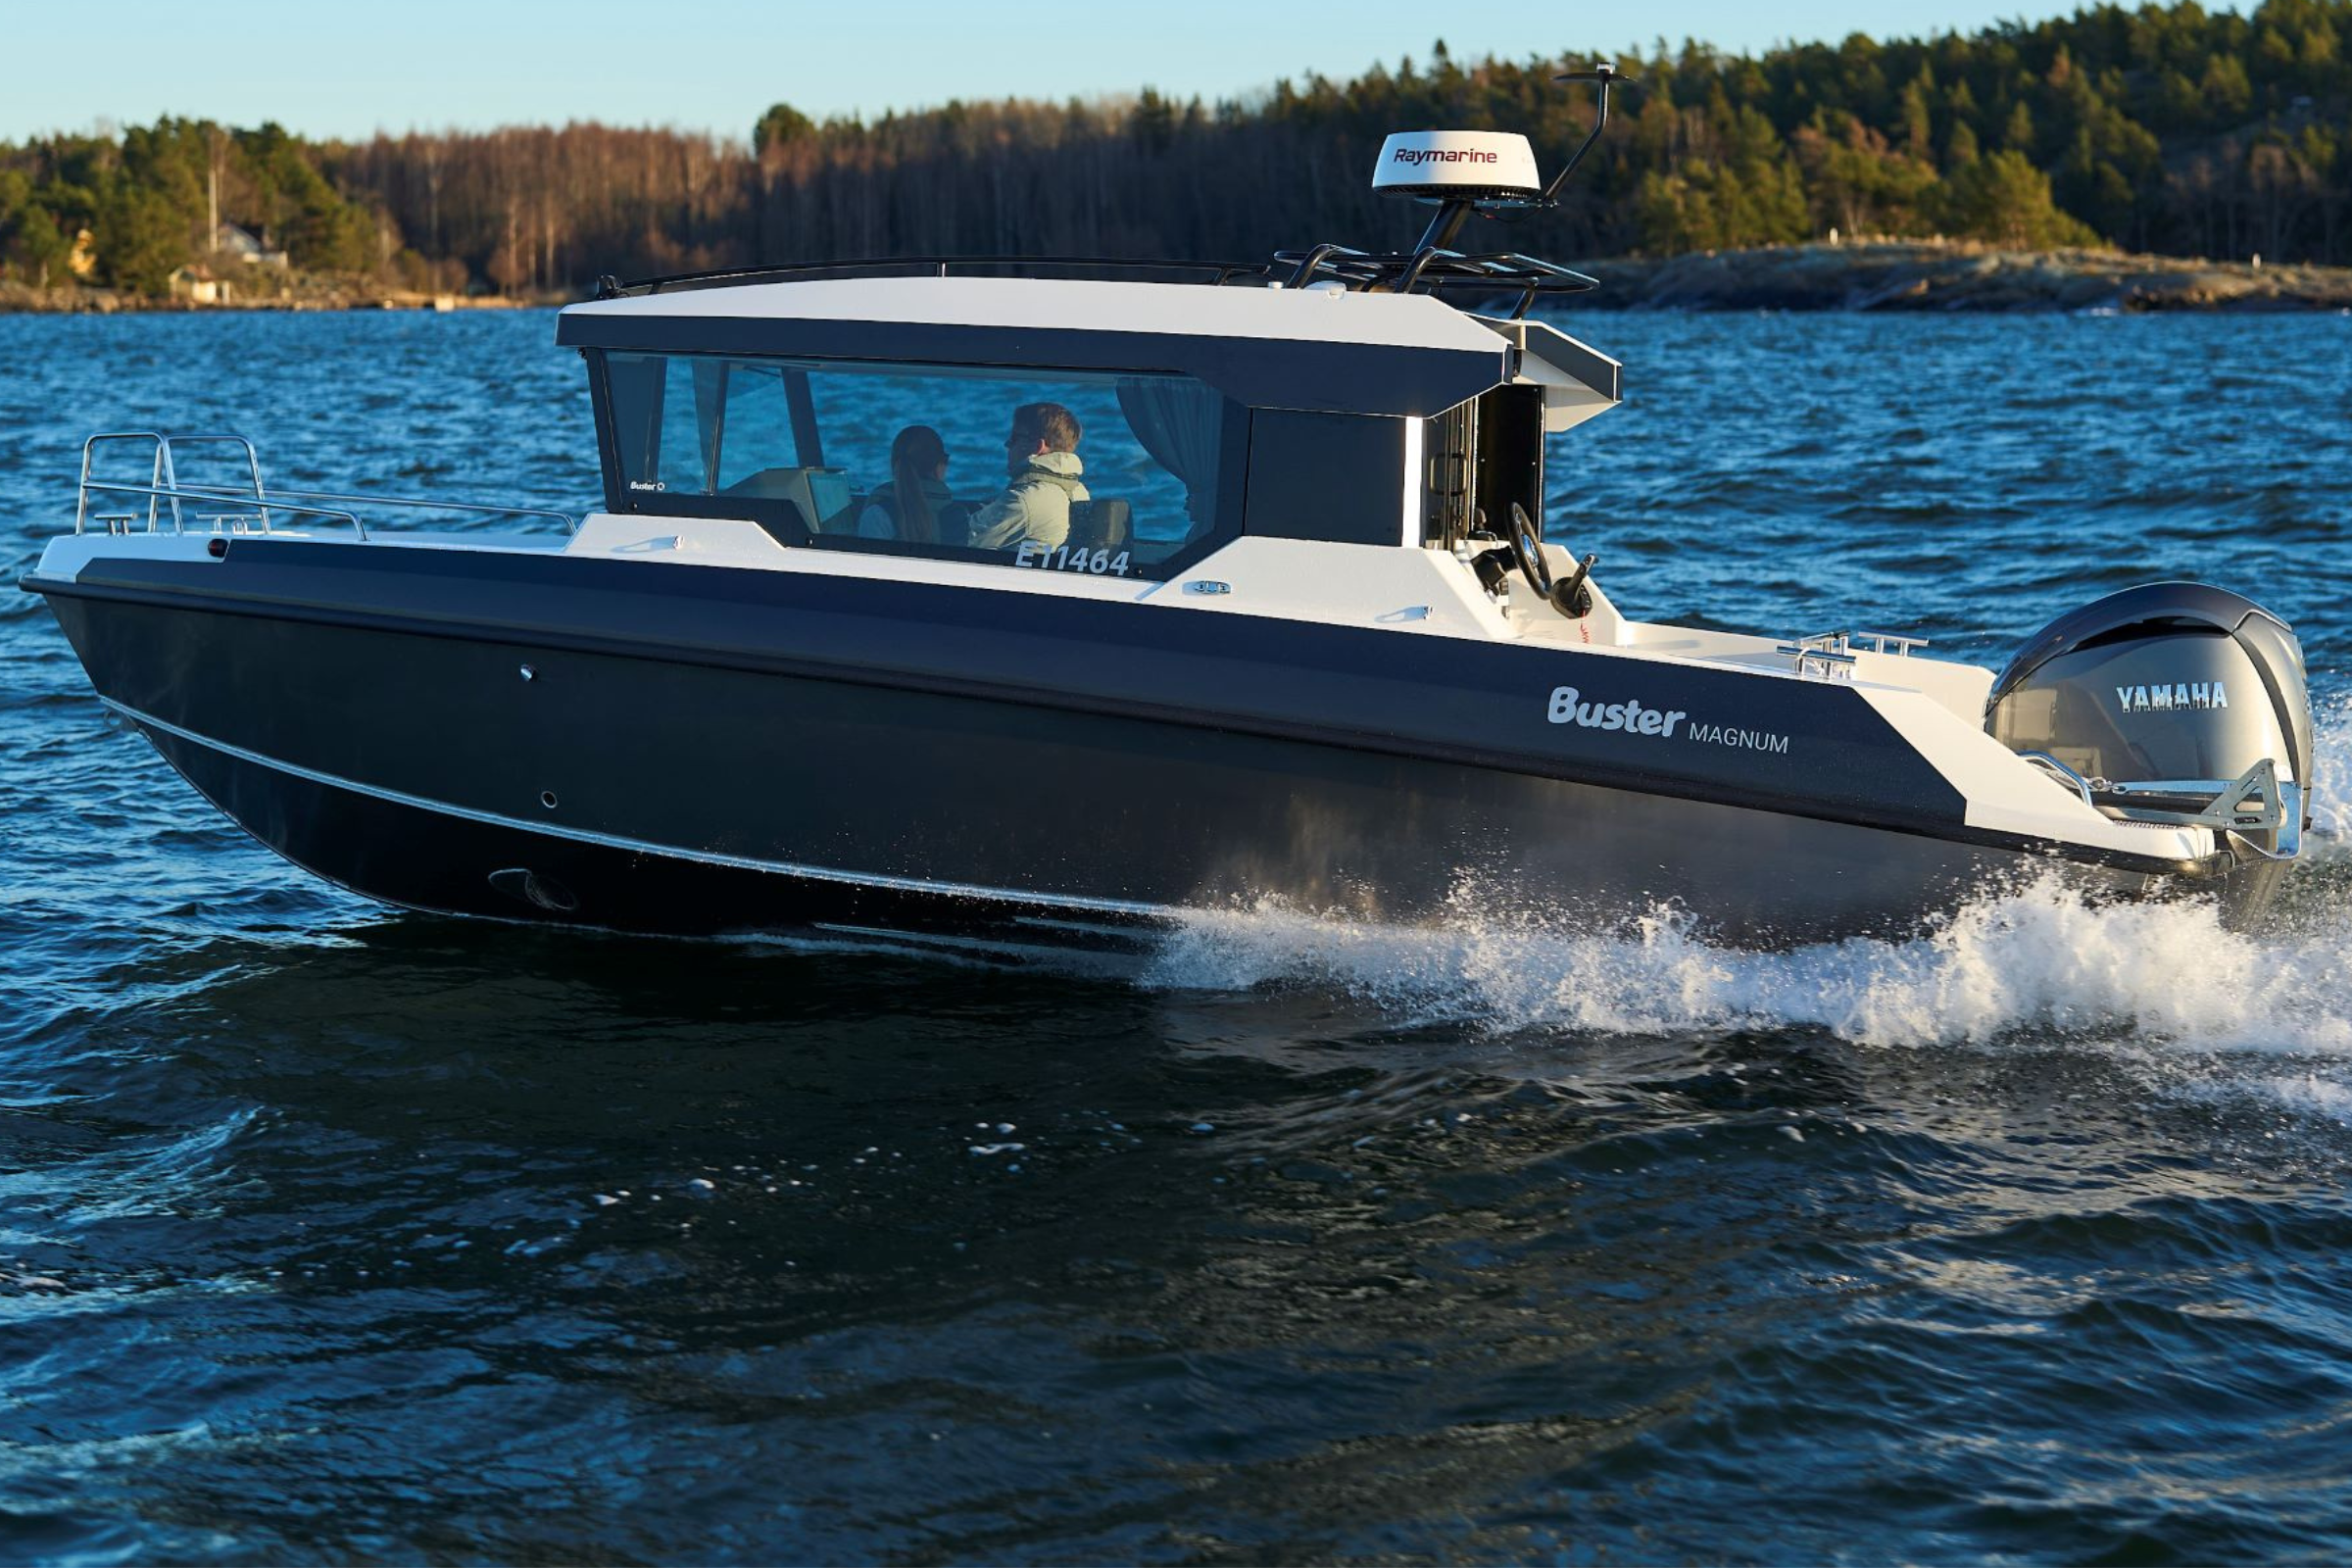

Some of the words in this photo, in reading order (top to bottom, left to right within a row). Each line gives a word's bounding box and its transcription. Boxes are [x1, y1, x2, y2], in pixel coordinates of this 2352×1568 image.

[1394, 148, 1497, 166] Raymarine
[630, 481, 656, 491] Buster
[1016, 541, 1130, 576] E11464
[2117, 681, 2229, 712] YAMAHA
[1547, 686, 1686, 736] Buster
[1690, 723, 1788, 754] MAGNUM
